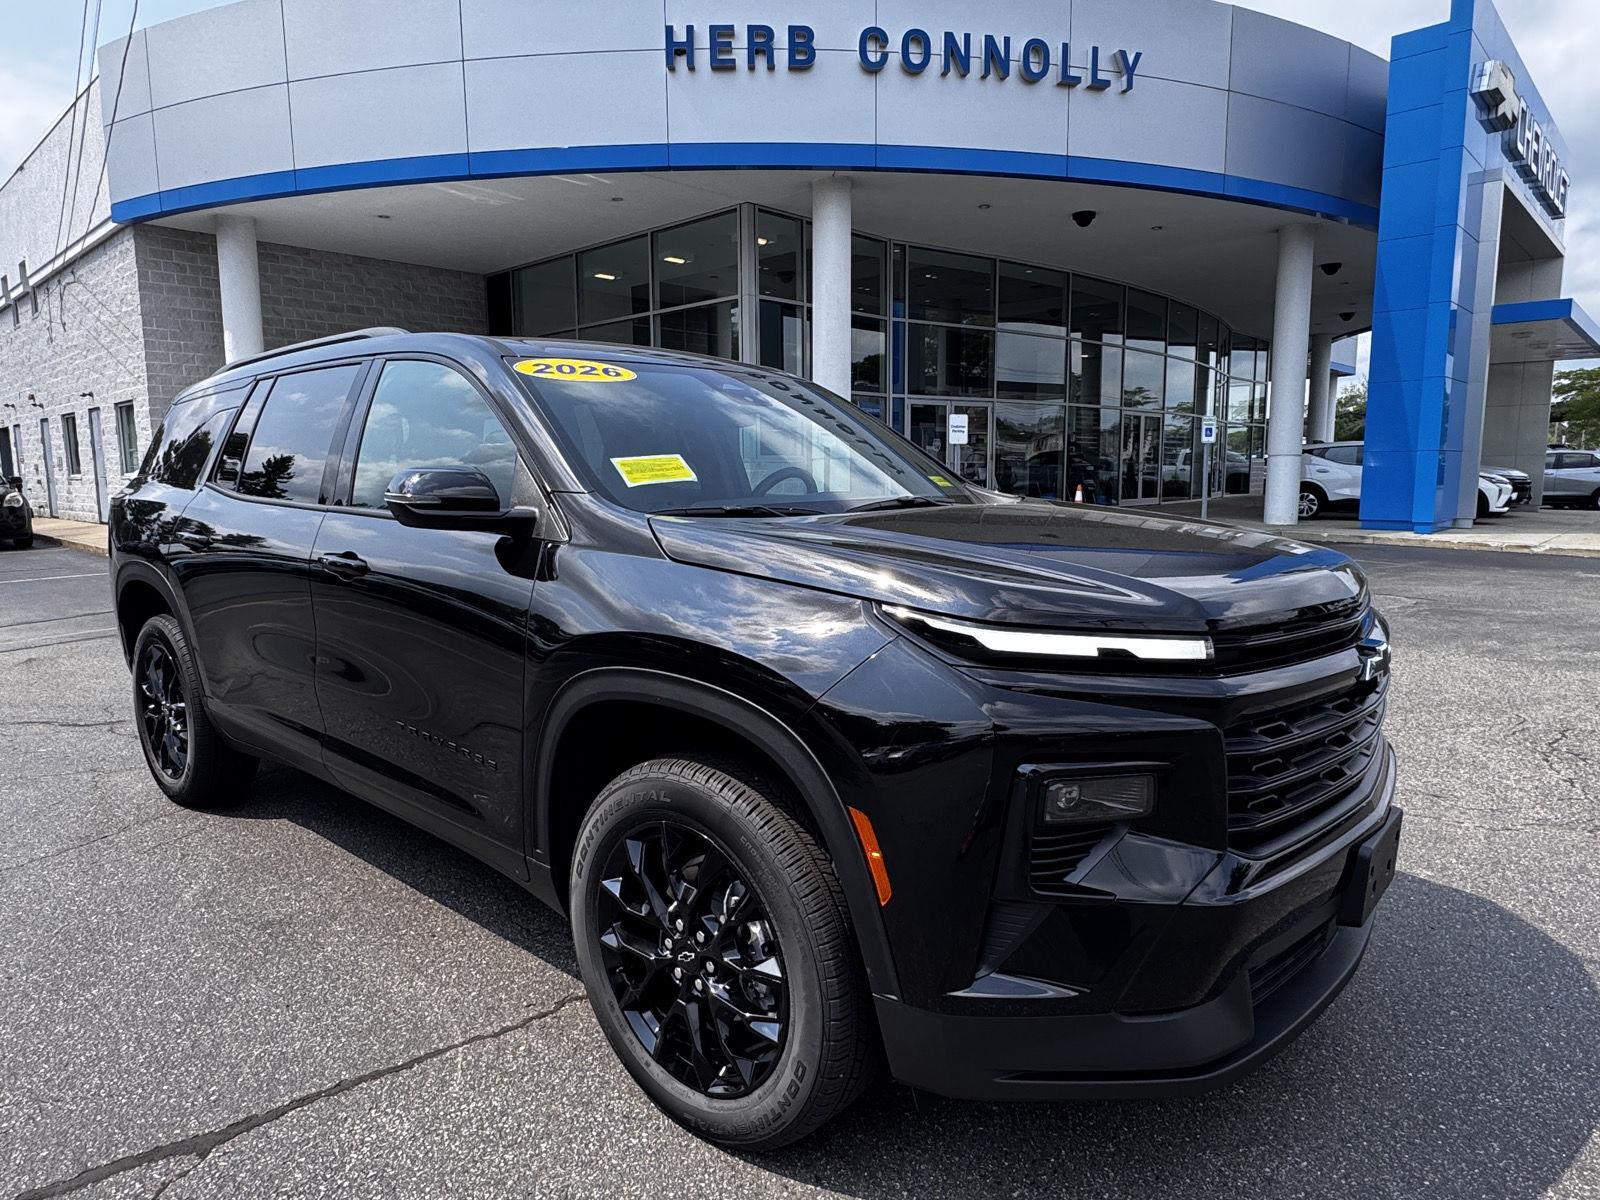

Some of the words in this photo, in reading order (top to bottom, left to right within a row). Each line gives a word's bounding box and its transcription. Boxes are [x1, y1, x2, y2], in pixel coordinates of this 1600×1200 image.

[665, 24, 817, 71] HERB
[858, 26, 1143, 94] CONNOLLY
[1516, 95, 1571, 219] CHEVROLET
[532, 362, 623, 378] 2026
[576, 789, 671, 879] CONTINENTAL
